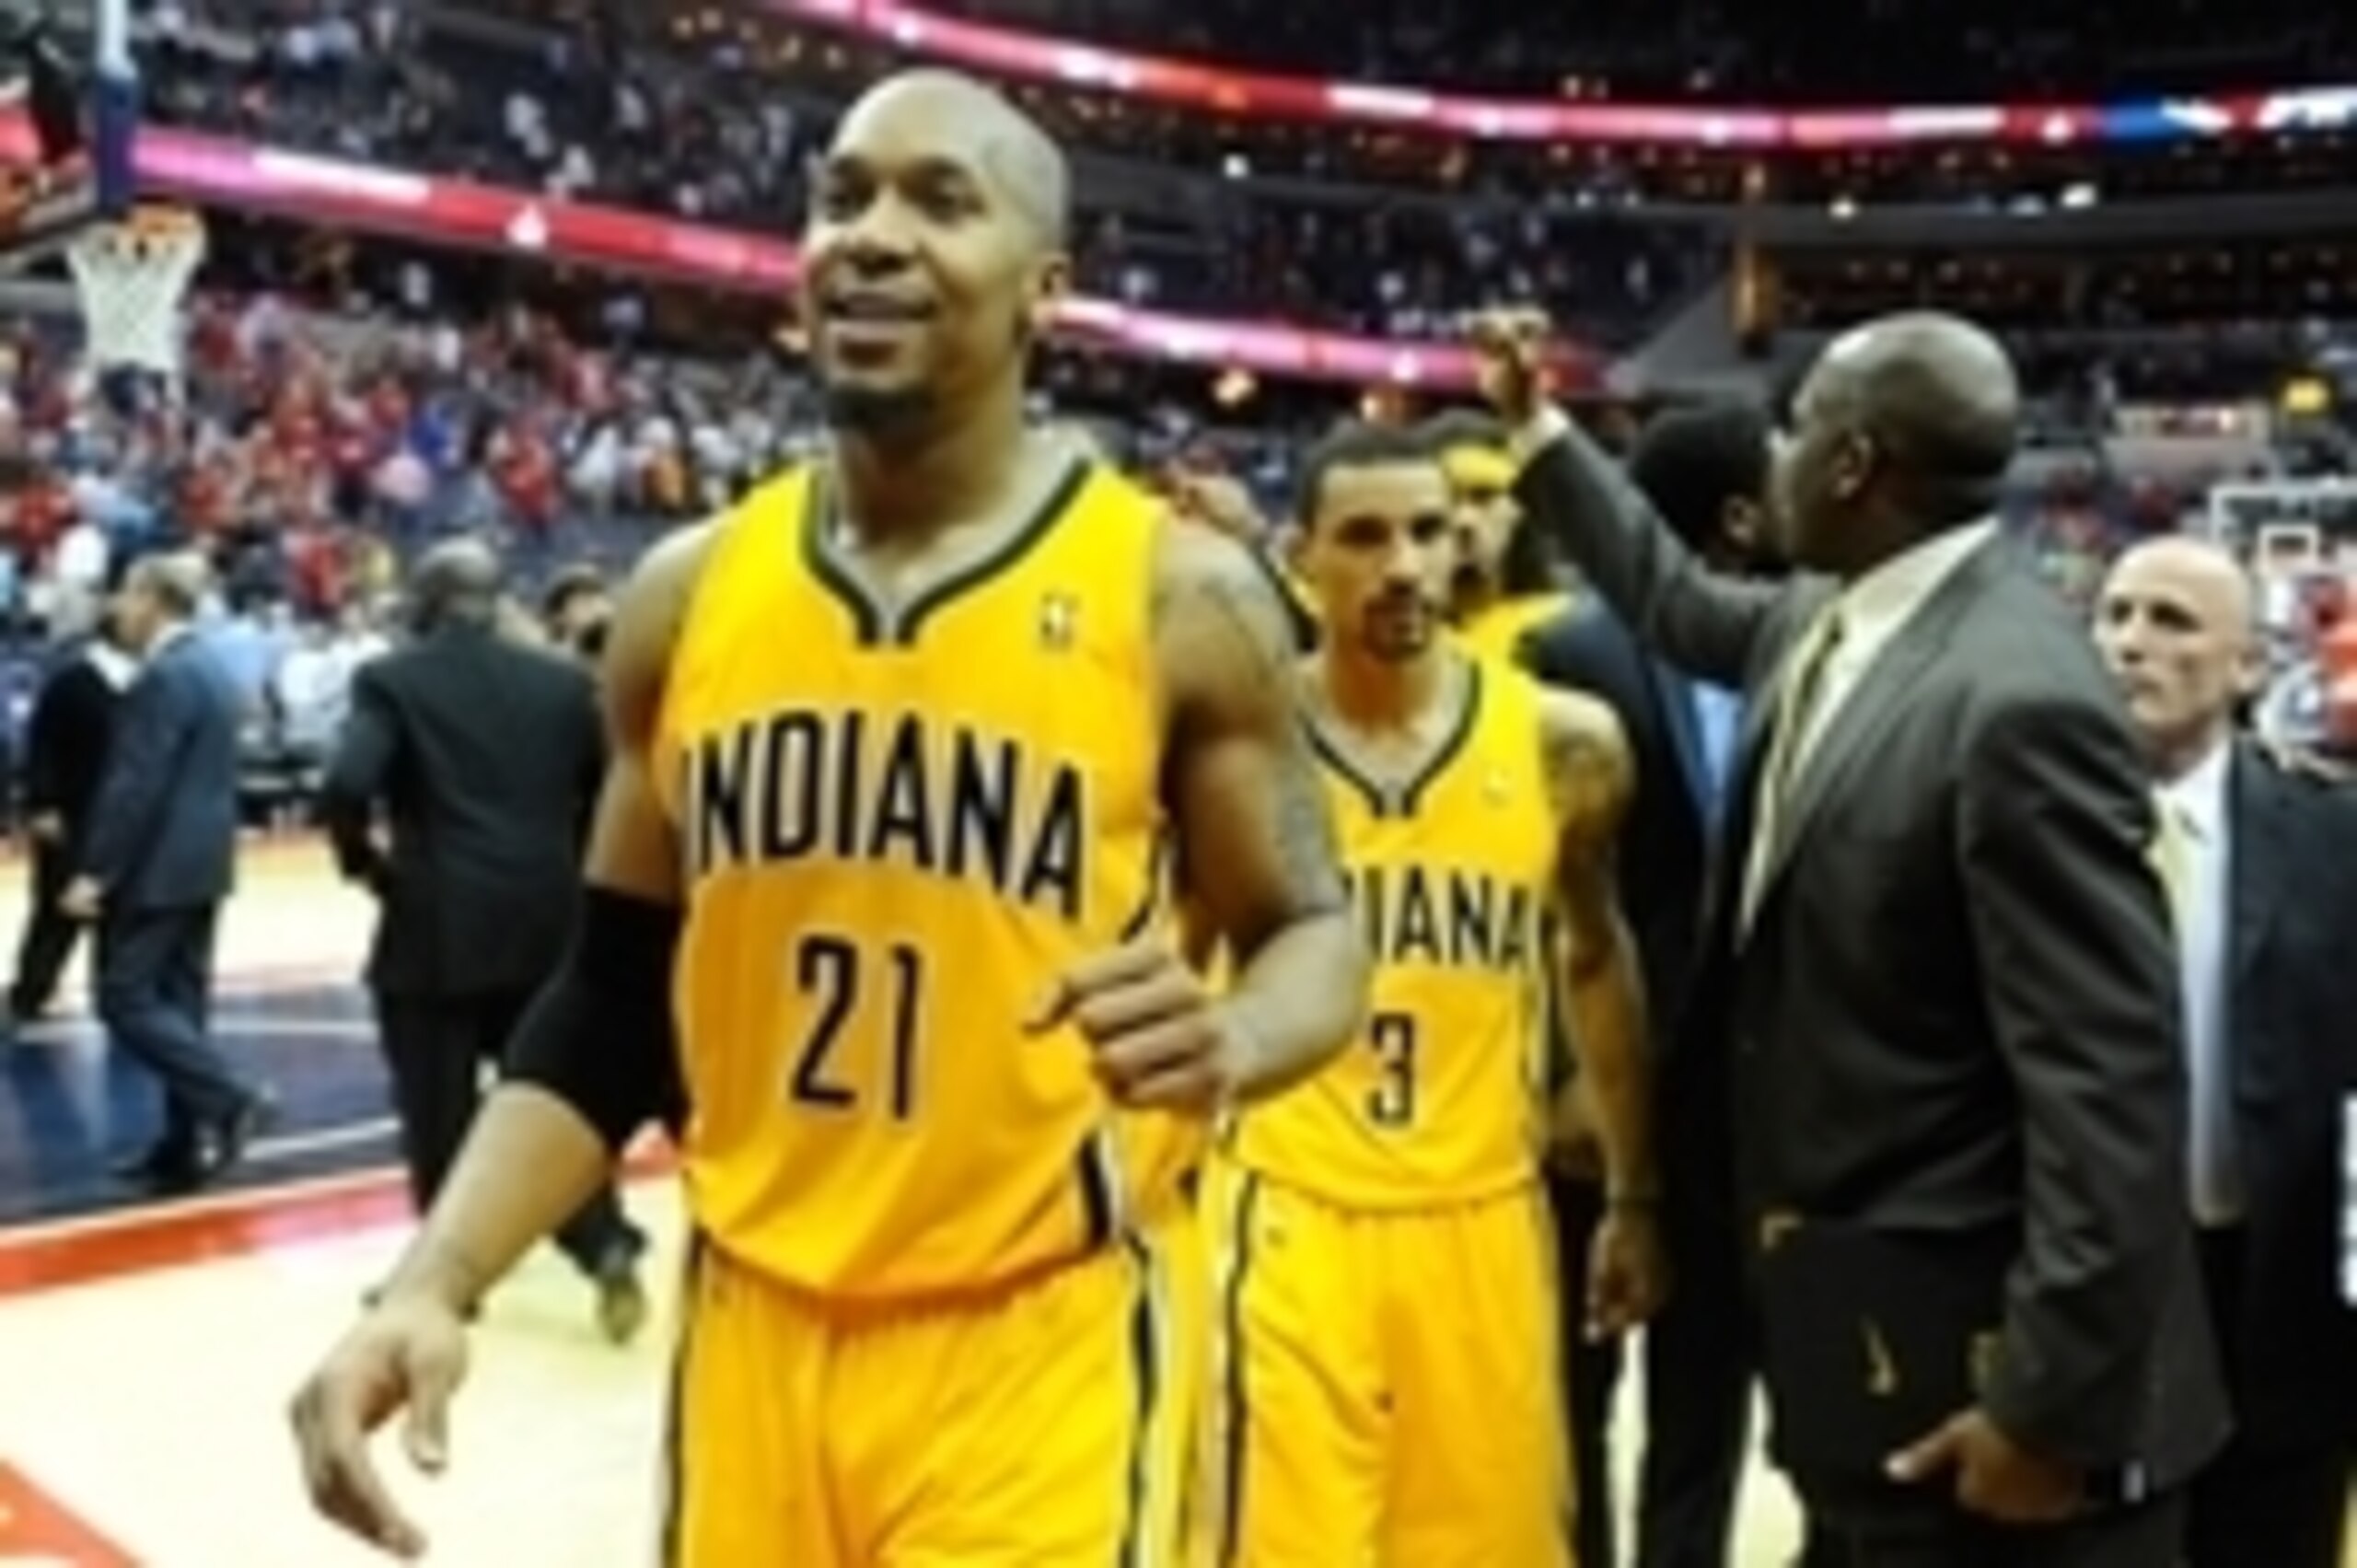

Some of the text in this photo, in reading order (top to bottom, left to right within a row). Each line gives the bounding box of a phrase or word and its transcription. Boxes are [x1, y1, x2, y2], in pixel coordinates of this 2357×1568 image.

[1340, 864, 1533, 972] IANA
[789, 934, 923, 1121] 21
[1366, 1012, 1416, 1127] 3
